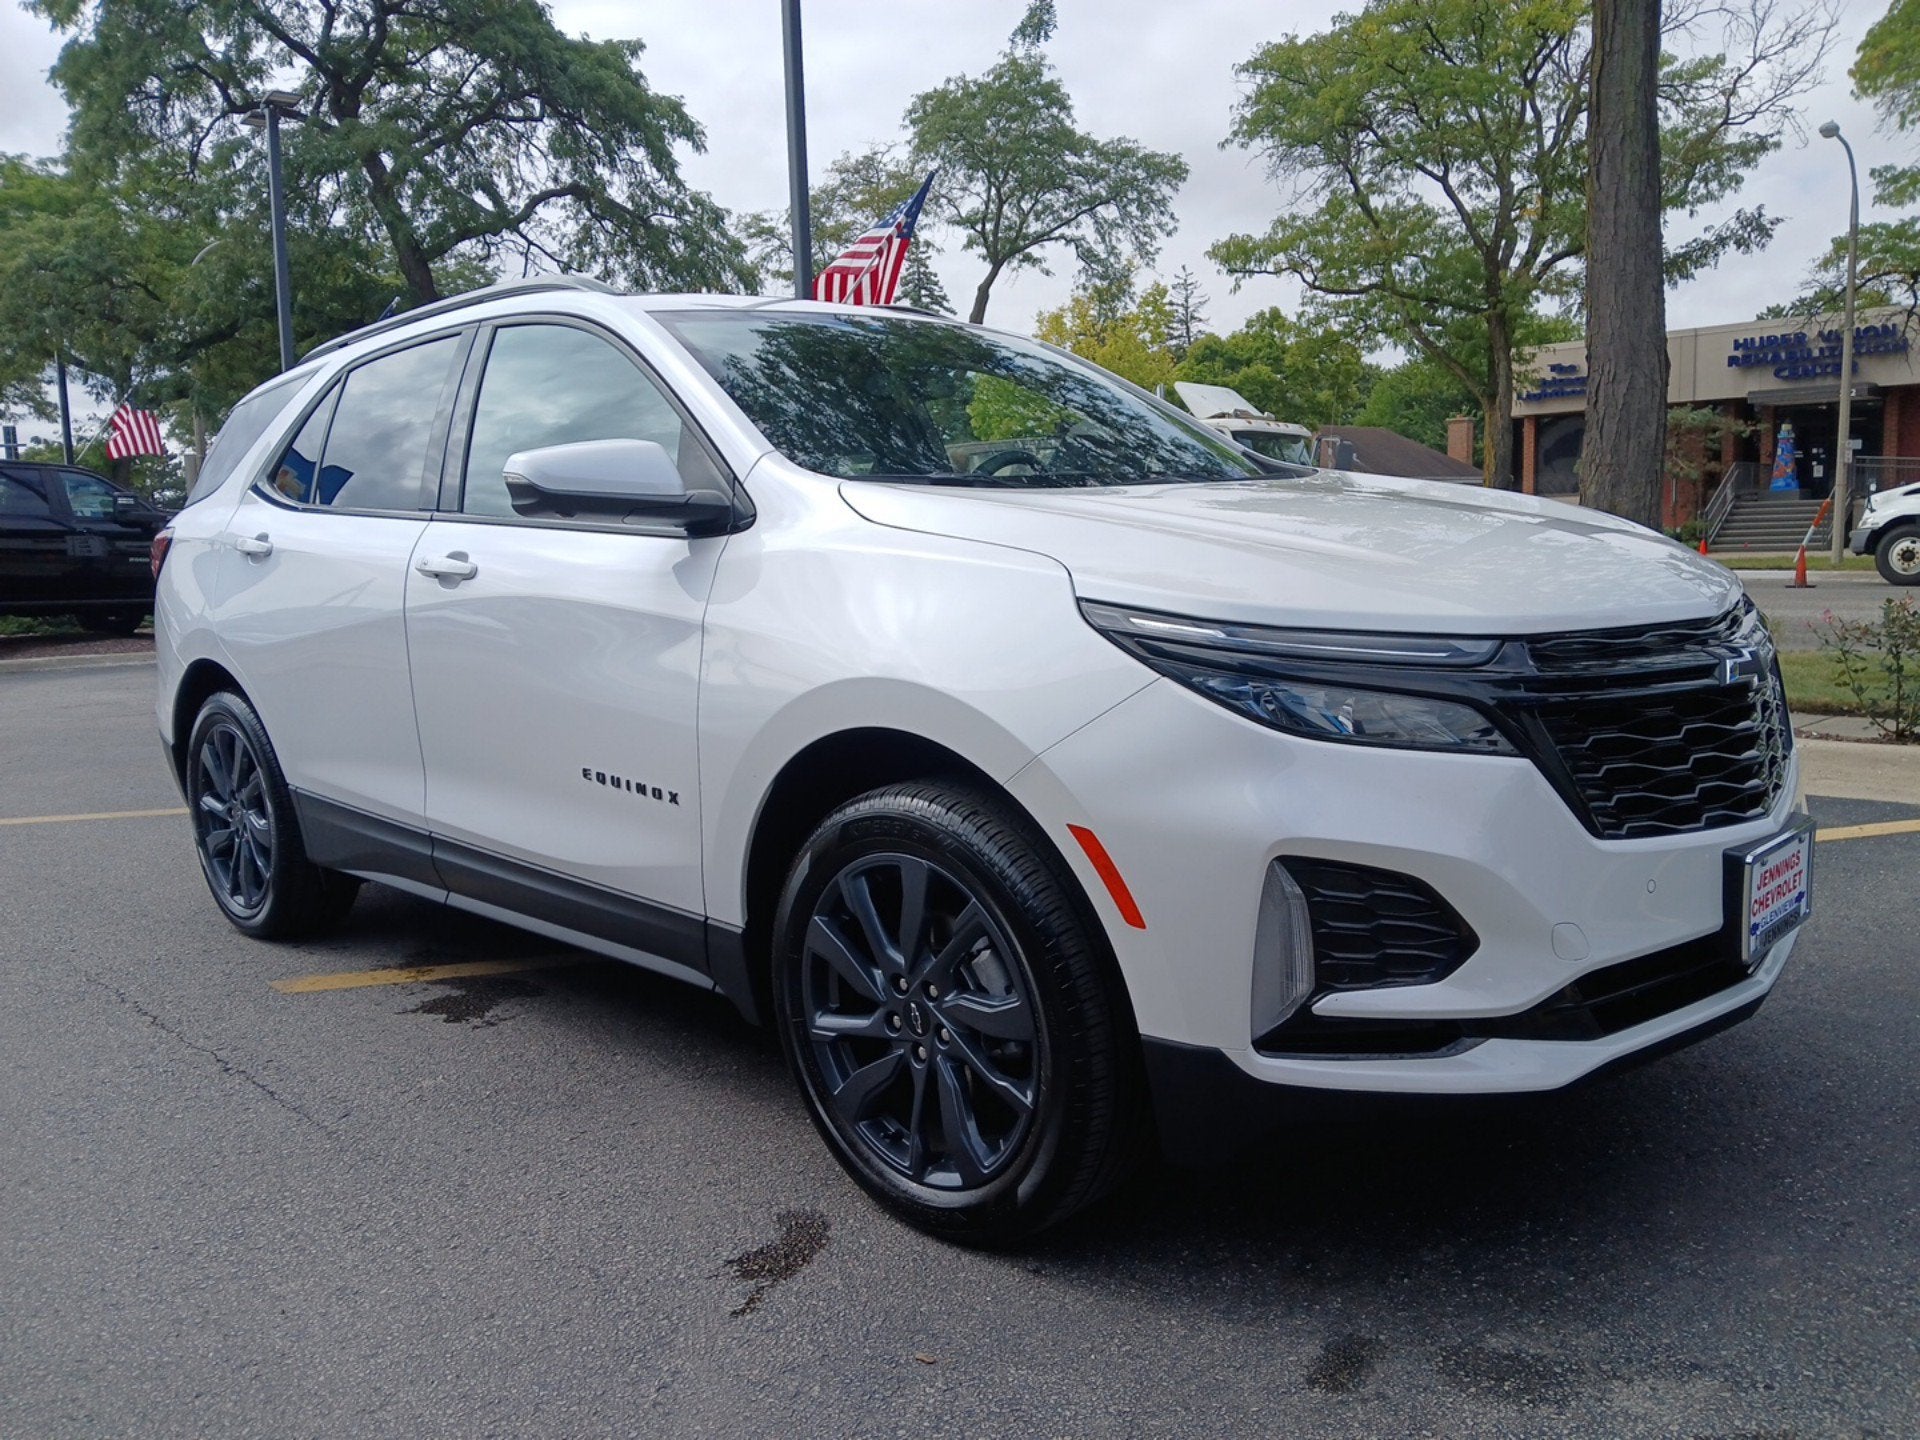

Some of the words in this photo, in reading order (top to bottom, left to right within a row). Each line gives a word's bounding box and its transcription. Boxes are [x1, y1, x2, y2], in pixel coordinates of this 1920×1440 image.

[1727, 337, 1909, 368] REHABILITTION
[1733, 331, 1808, 352] HUBER
[1818, 323, 1899, 343] VIION
[582, 767, 680, 806] EQUINOX
[1756, 849, 1801, 891] JENNINGS
[1751, 869, 1804, 917] CHEVROLET
[1760, 897, 1796, 928] GLENVIEW
